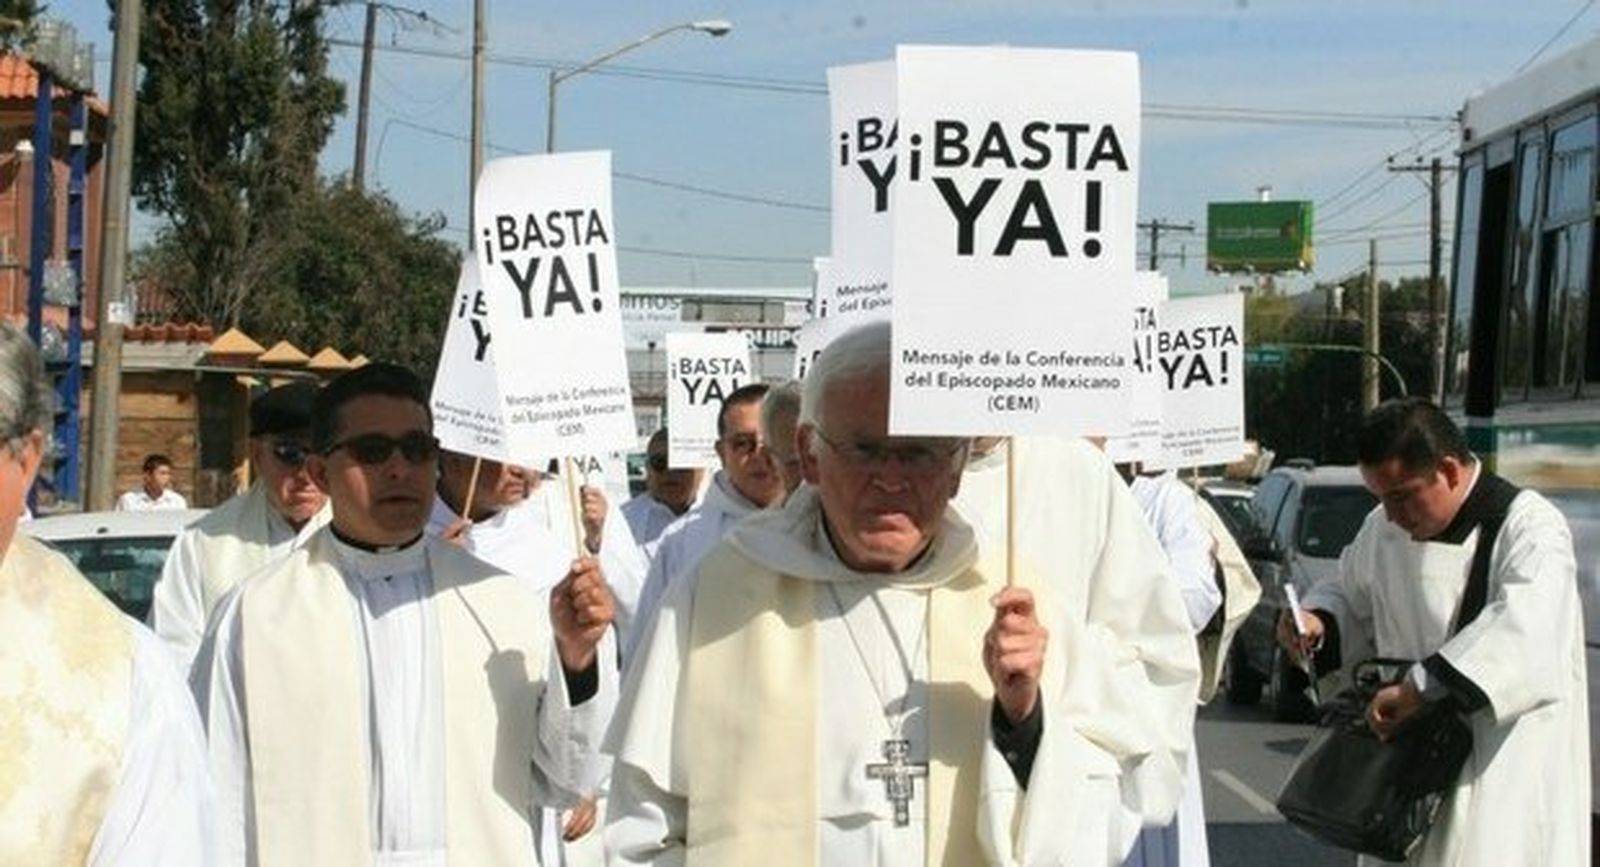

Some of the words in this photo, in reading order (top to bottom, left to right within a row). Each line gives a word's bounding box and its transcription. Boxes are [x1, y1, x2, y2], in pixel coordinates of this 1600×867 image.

[910, 120, 1129, 181] ¡BASTA
[932, 177, 1102, 258] YA!
[484, 209, 608, 264] ¡BASTA
[502, 252, 602, 319] YA!
[1158, 325, 1239, 352] BASTA
[671, 357, 747, 380] ¡BASTA
[902, 350, 974, 369] Mensaje
[979, 351, 1001, 366] de
[1005, 351, 1021, 367] la
[1026, 351, 1125, 368] Conferencia
[1159, 351, 1228, 390] YA!
[905, 371, 932, 387] del
[938, 373, 1036, 391] Episcopado
[1042, 374, 1121, 389] Mexicano
[988, 395, 1040, 413] (CEM)
